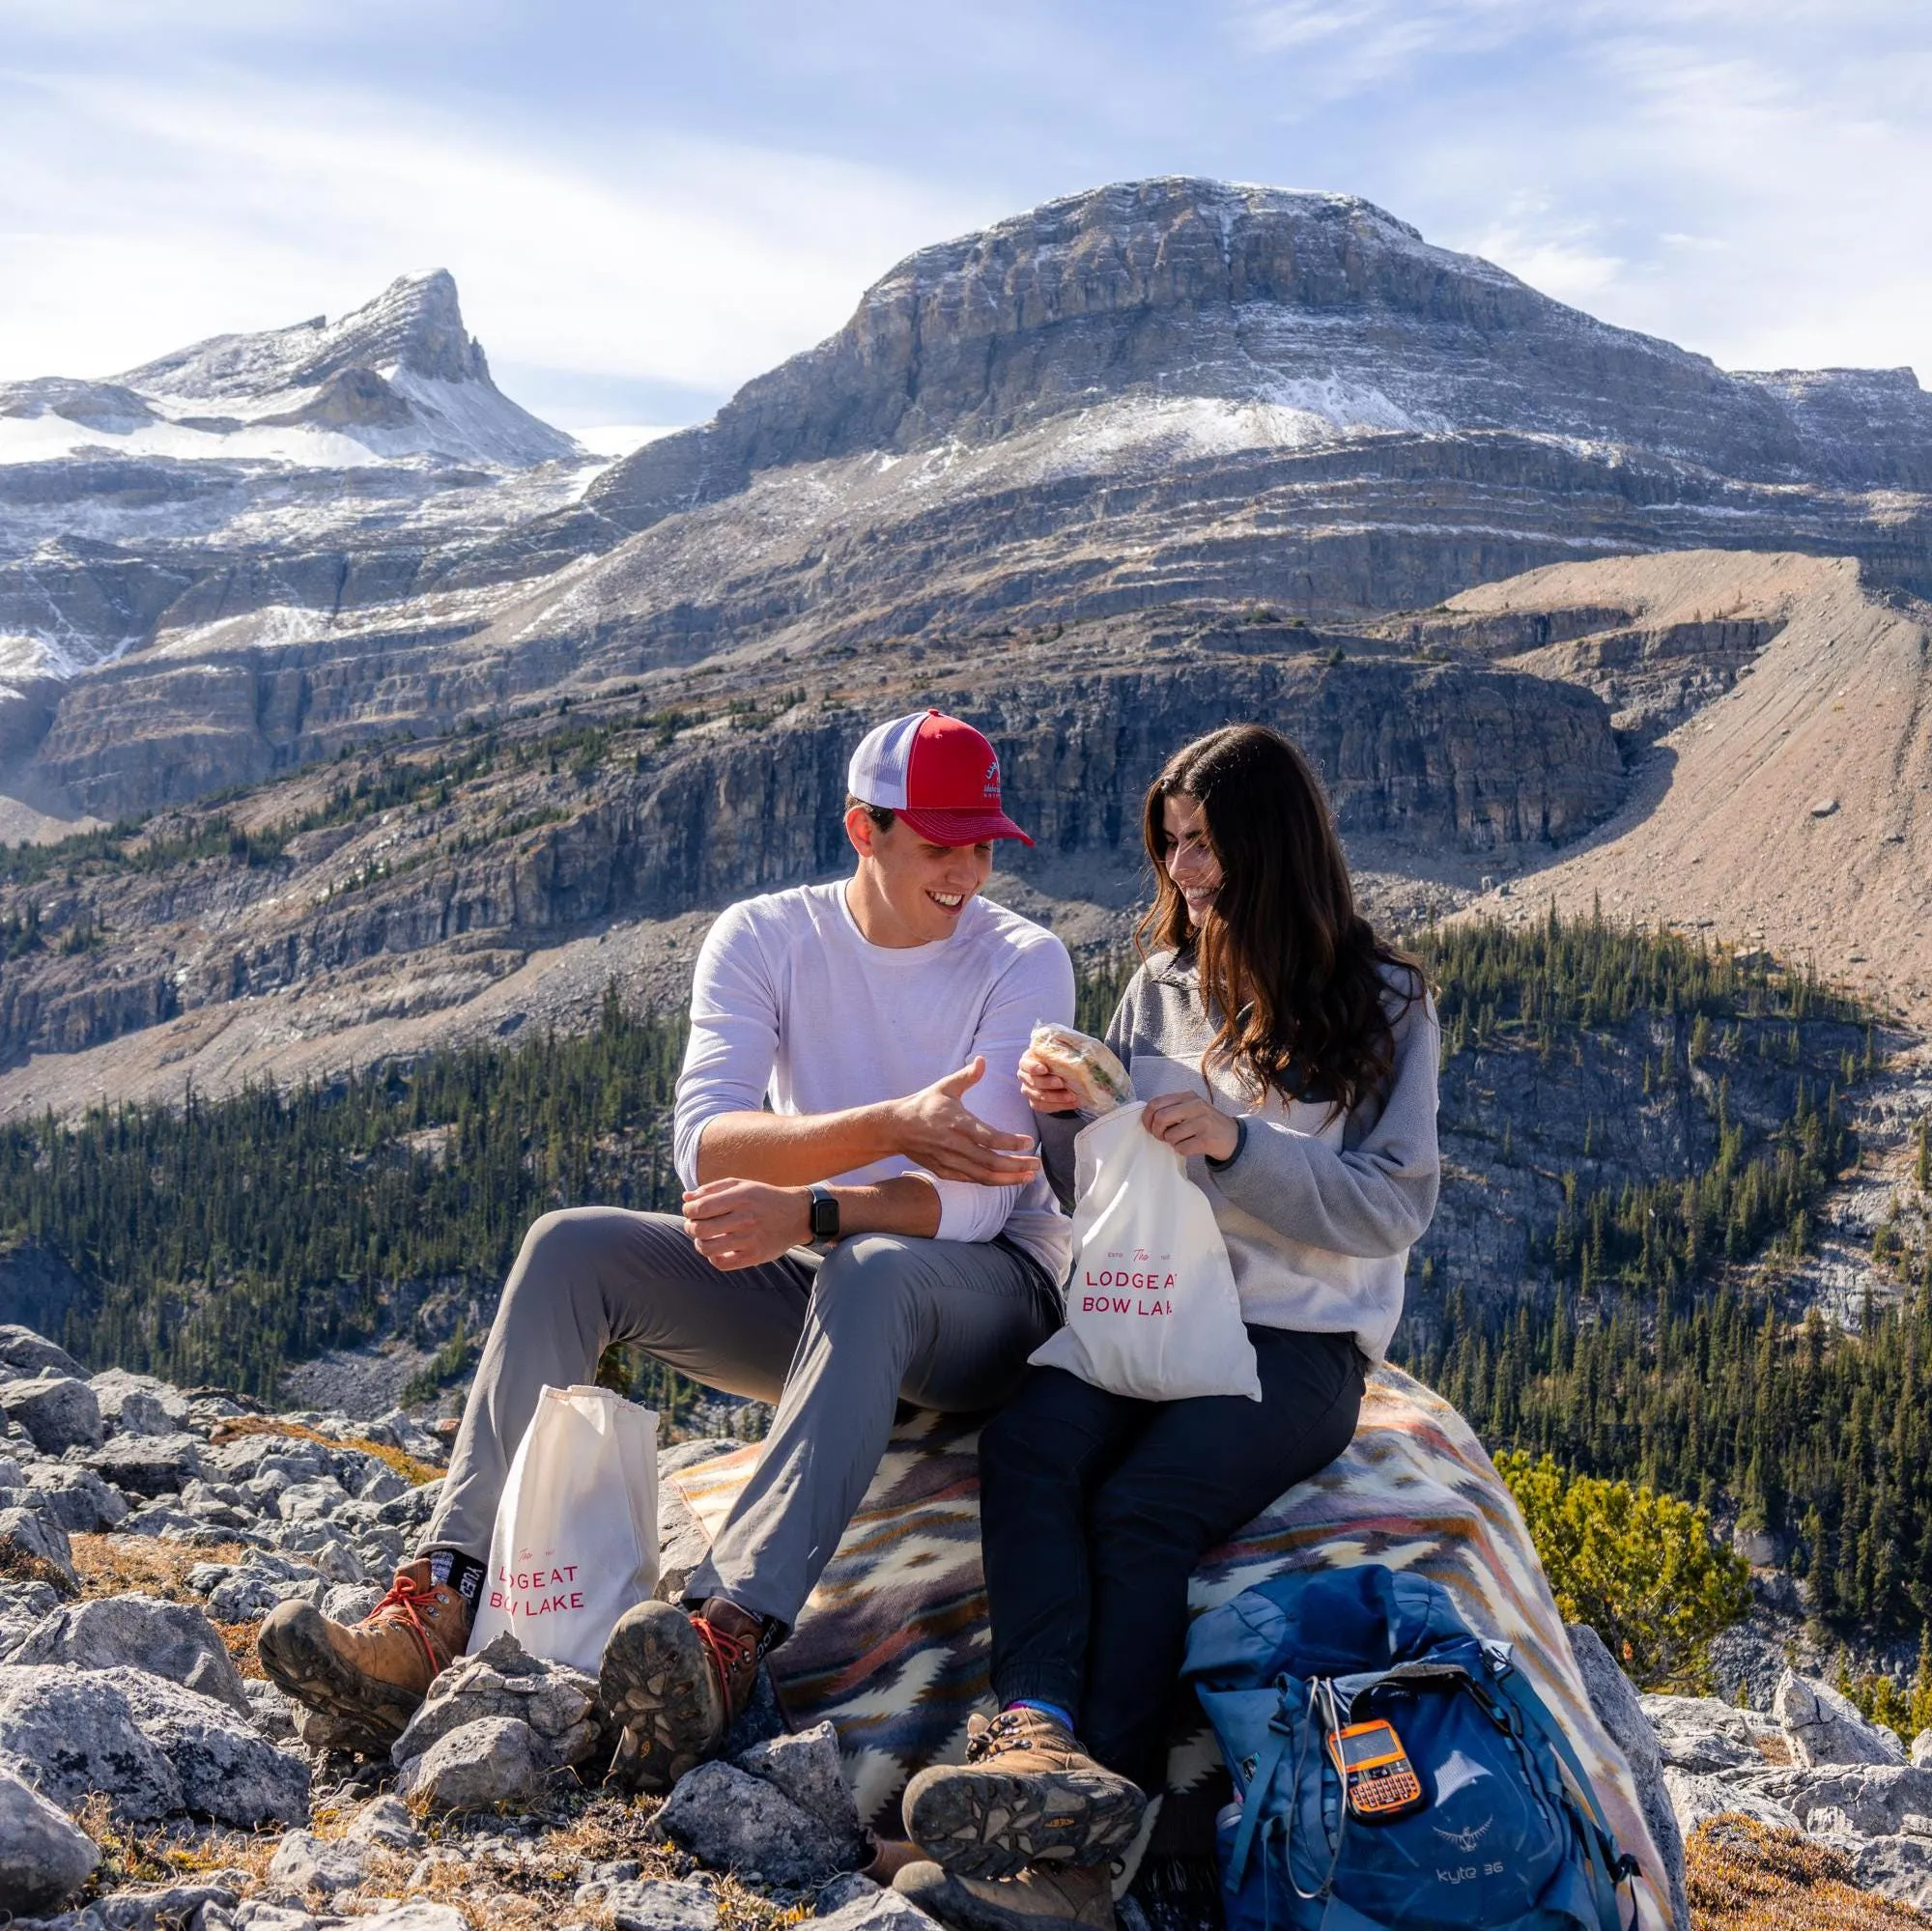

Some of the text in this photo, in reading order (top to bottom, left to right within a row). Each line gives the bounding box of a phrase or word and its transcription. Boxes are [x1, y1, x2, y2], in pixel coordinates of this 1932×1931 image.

[1133, 1248, 1150, 1263] The
[1086, 1271, 1178, 1290] LODGE A
[1082, 1296, 1131, 1314] BOW
[550, 1566, 579, 1584] AT
[526, 1592, 584, 1616] LAKE
[1435, 1860, 1504, 1885] kyte 36
